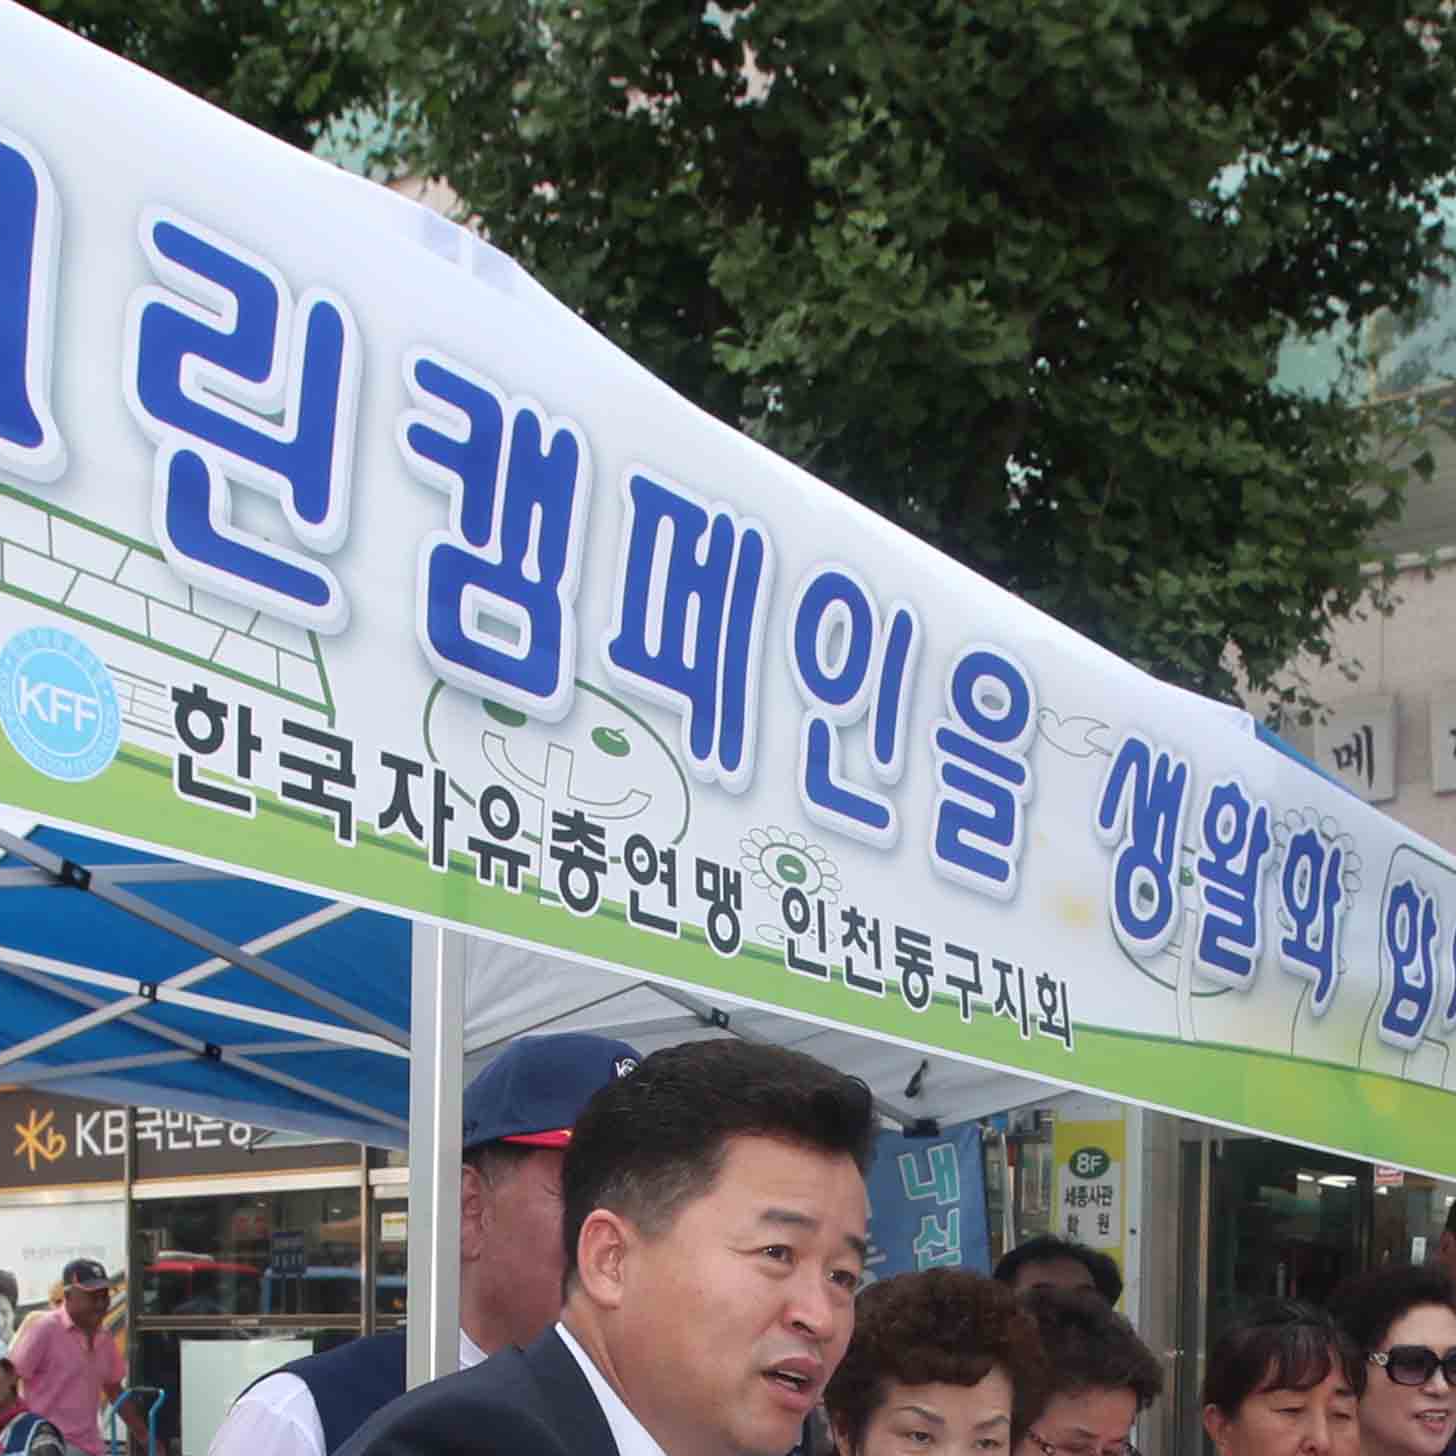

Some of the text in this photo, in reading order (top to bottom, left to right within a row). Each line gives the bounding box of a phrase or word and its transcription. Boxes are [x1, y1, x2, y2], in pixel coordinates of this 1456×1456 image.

[19, 674, 98, 733] KFF
[170, 684, 1075, 1049] 한국자유총연맹 인천동구지회
[1077, 1152, 1104, 1174] 8F
